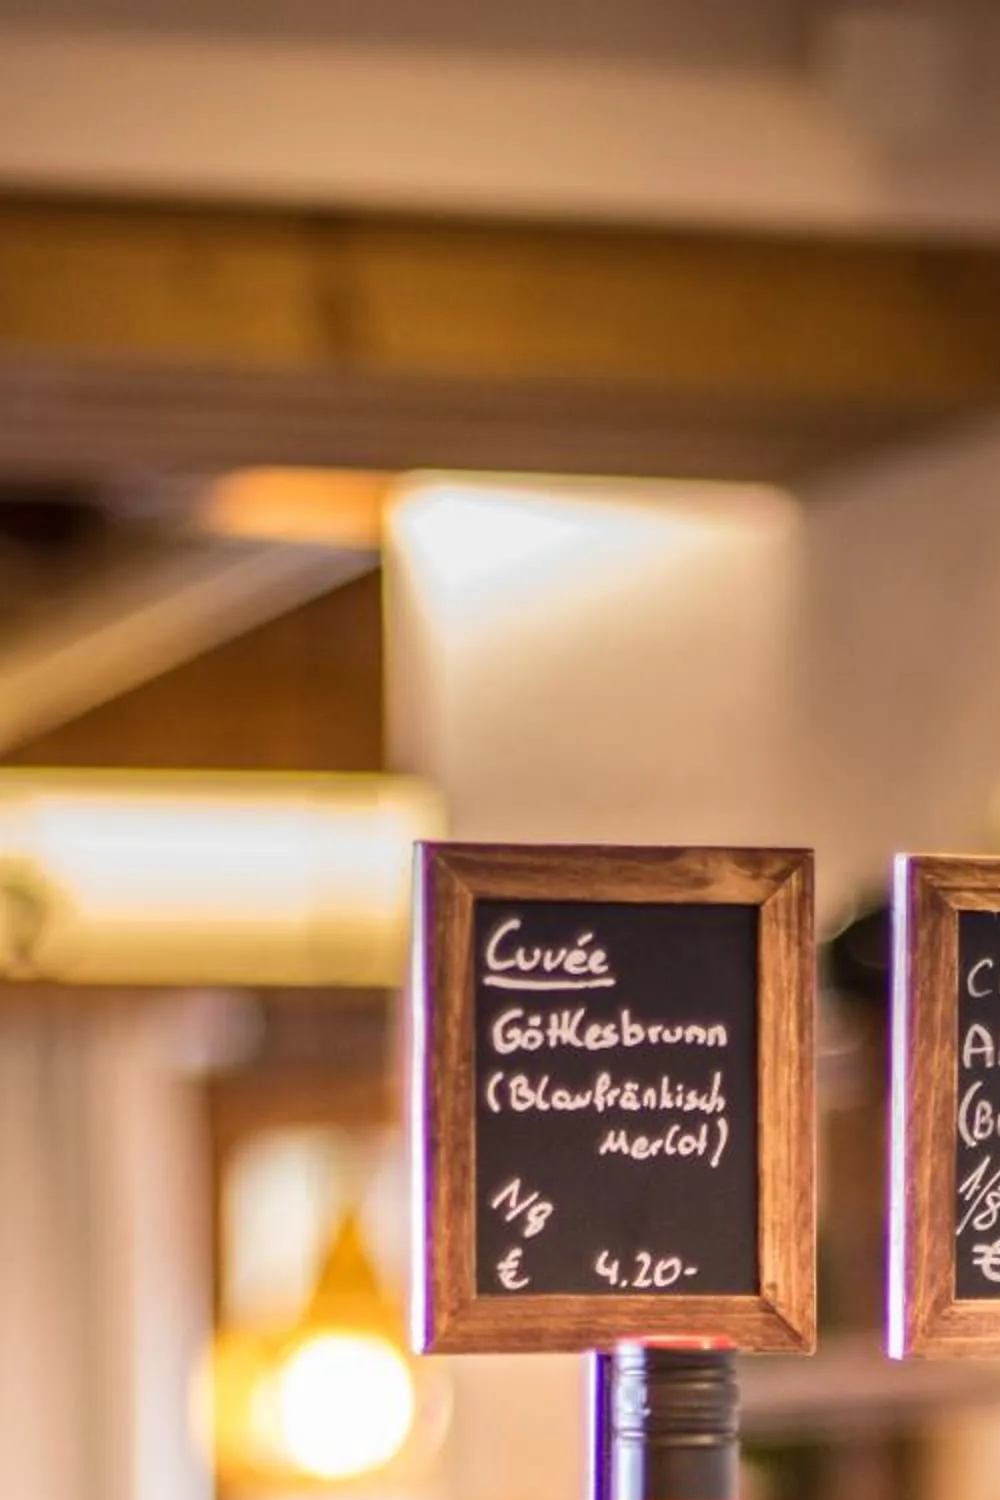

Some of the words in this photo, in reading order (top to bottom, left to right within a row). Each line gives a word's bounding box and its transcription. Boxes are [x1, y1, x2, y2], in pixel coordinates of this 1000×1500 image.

[485, 918, 609, 975] Cuvée
[599, 1117, 729, 1169] Merlot)
[491, 1177, 554, 1238] 1/8
[496, 1247, 530, 1290] €
